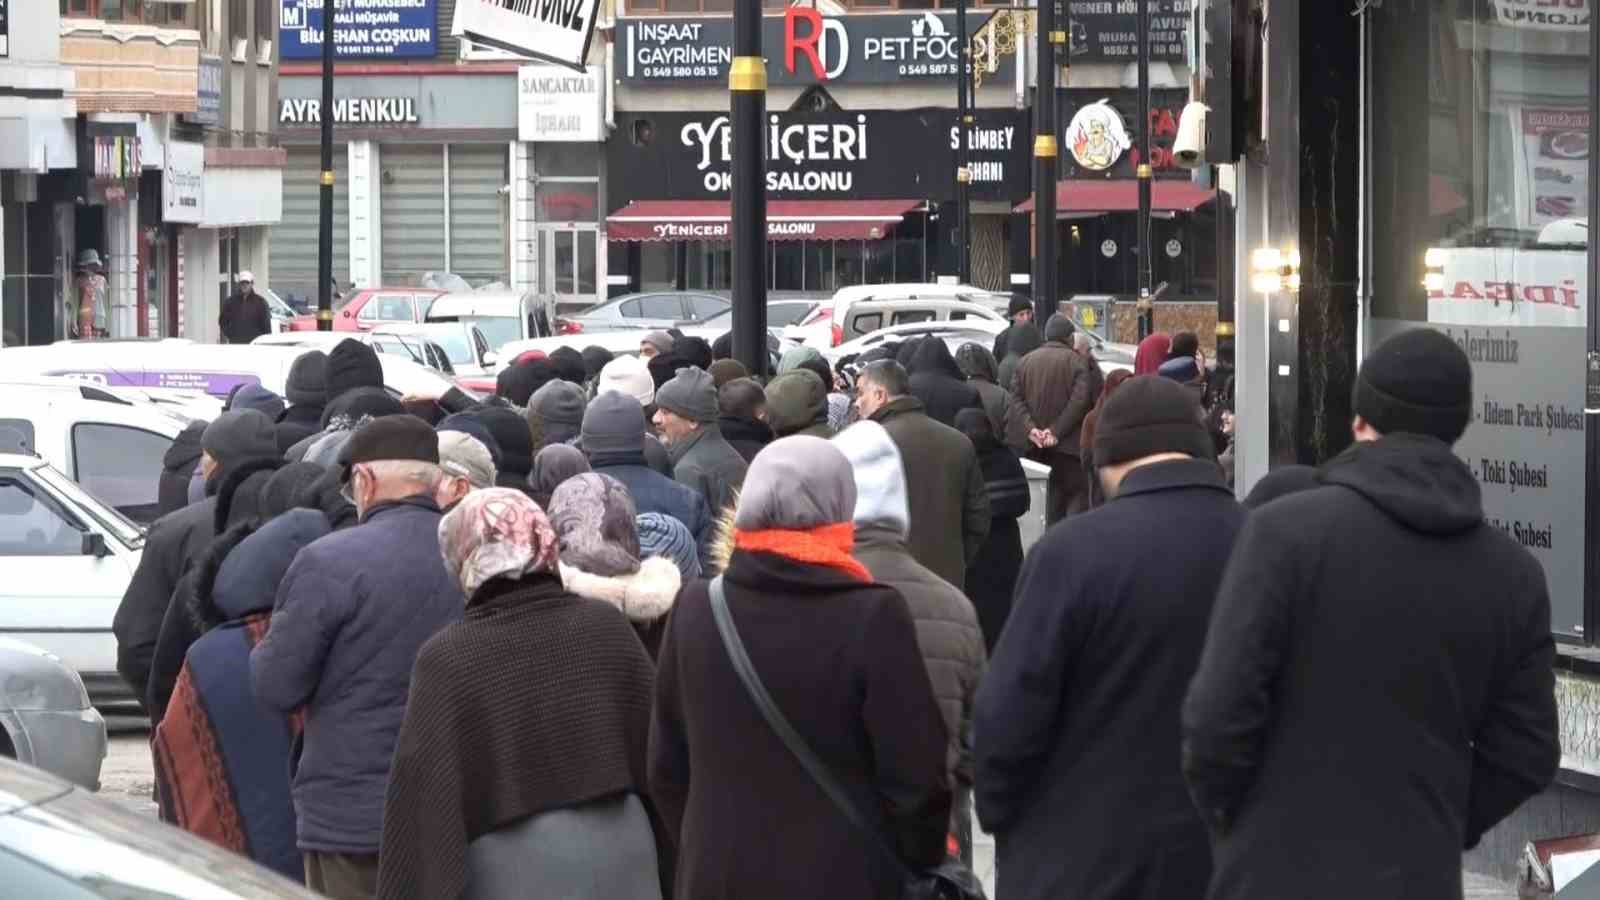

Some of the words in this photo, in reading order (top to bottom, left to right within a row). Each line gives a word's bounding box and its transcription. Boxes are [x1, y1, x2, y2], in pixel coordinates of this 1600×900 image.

[283, 8, 299, 25] M
[371, 28, 430, 46] COŞKUN
[638, 21, 702, 45] İNŞAAT
[638, 44, 731, 65] GAYRİMEN
[644, 67, 651, 77] 0
[653, 67, 671, 77] 549
[708, 66, 718, 76] 15
[899, 65, 906, 75] 0
[908, 65, 927, 75] 549
[951, 126, 1014, 150] SLİMBEY
[766, 171, 852, 191] SALONU
[768, 223, 817, 235] SALONU
[1483, 395, 1514, 425] İldem
[1516, 403, 1543, 427] Park
[1545, 404, 1584, 437] Şubesi
[1481, 458, 1506, 484] Toki
[1509, 460, 1548, 493] Şubesi
